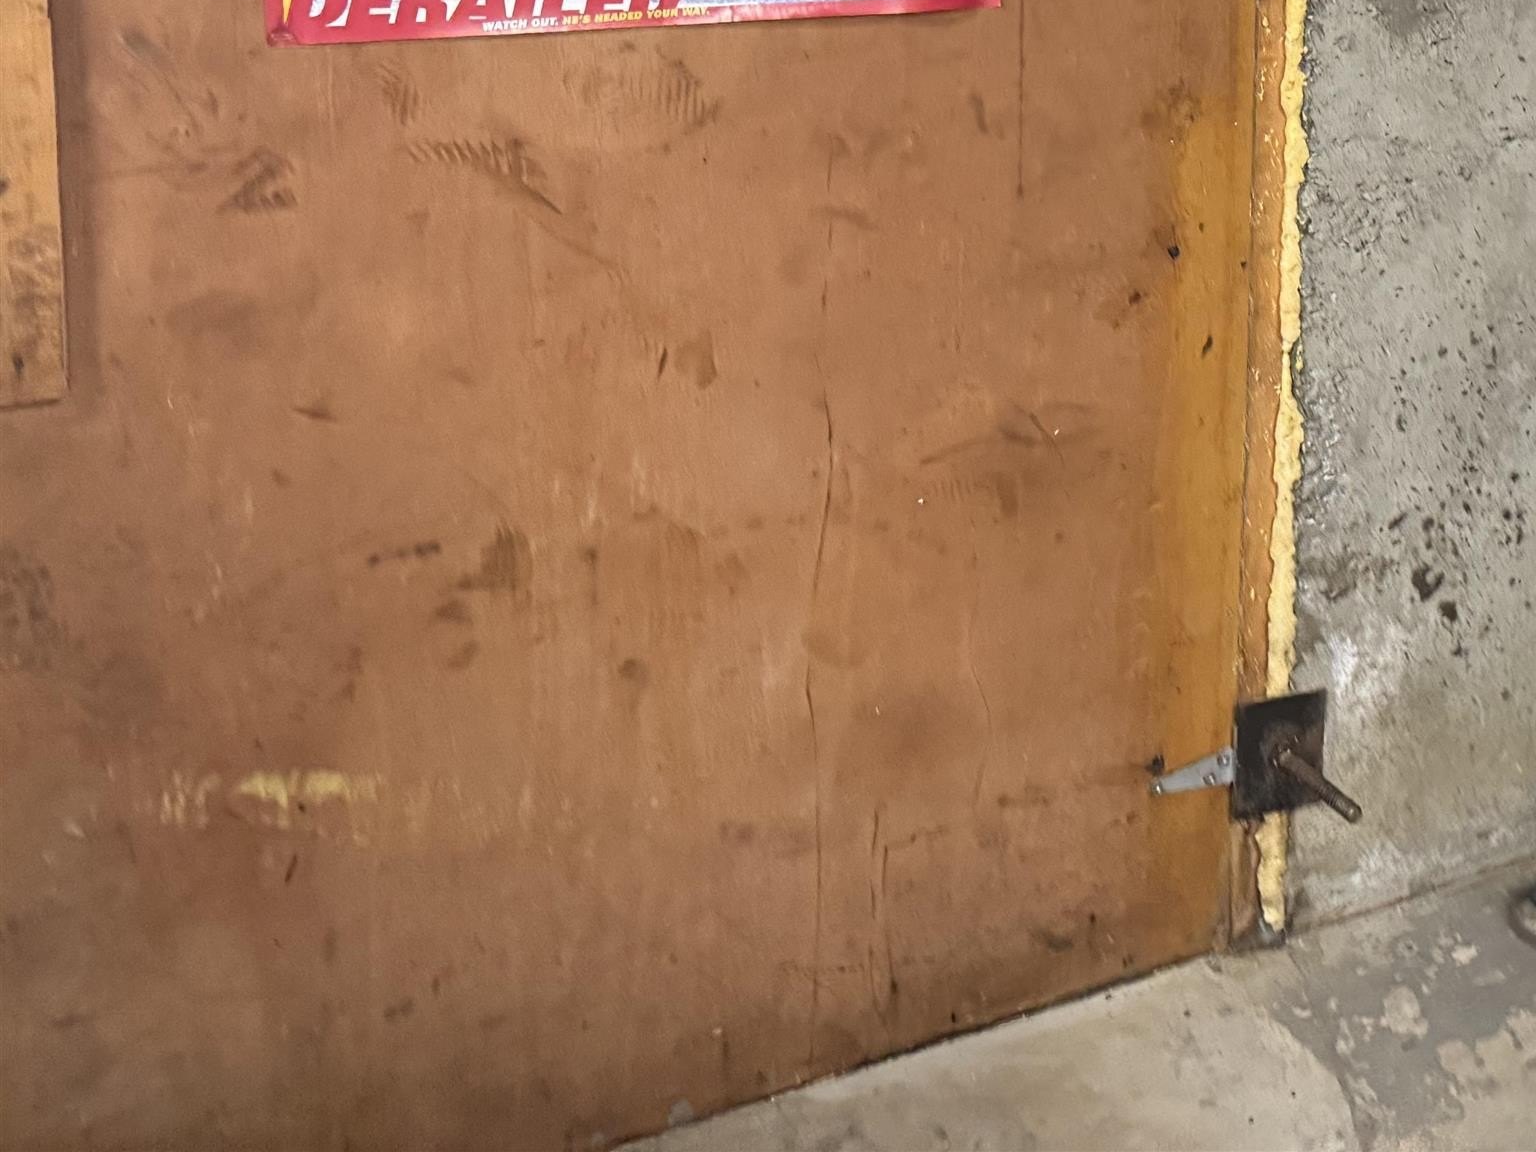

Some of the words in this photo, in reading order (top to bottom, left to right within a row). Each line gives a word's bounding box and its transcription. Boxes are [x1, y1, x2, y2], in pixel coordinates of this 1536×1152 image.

[482, 20, 527, 32] WATCH
[531, 16, 559, 28] OUT.
[562, 14, 591, 26] HE'S
[594, 11, 643, 24] HEADED
[647, 7, 678, 20] YOUR
[681, 5, 711, 17] WAY.
